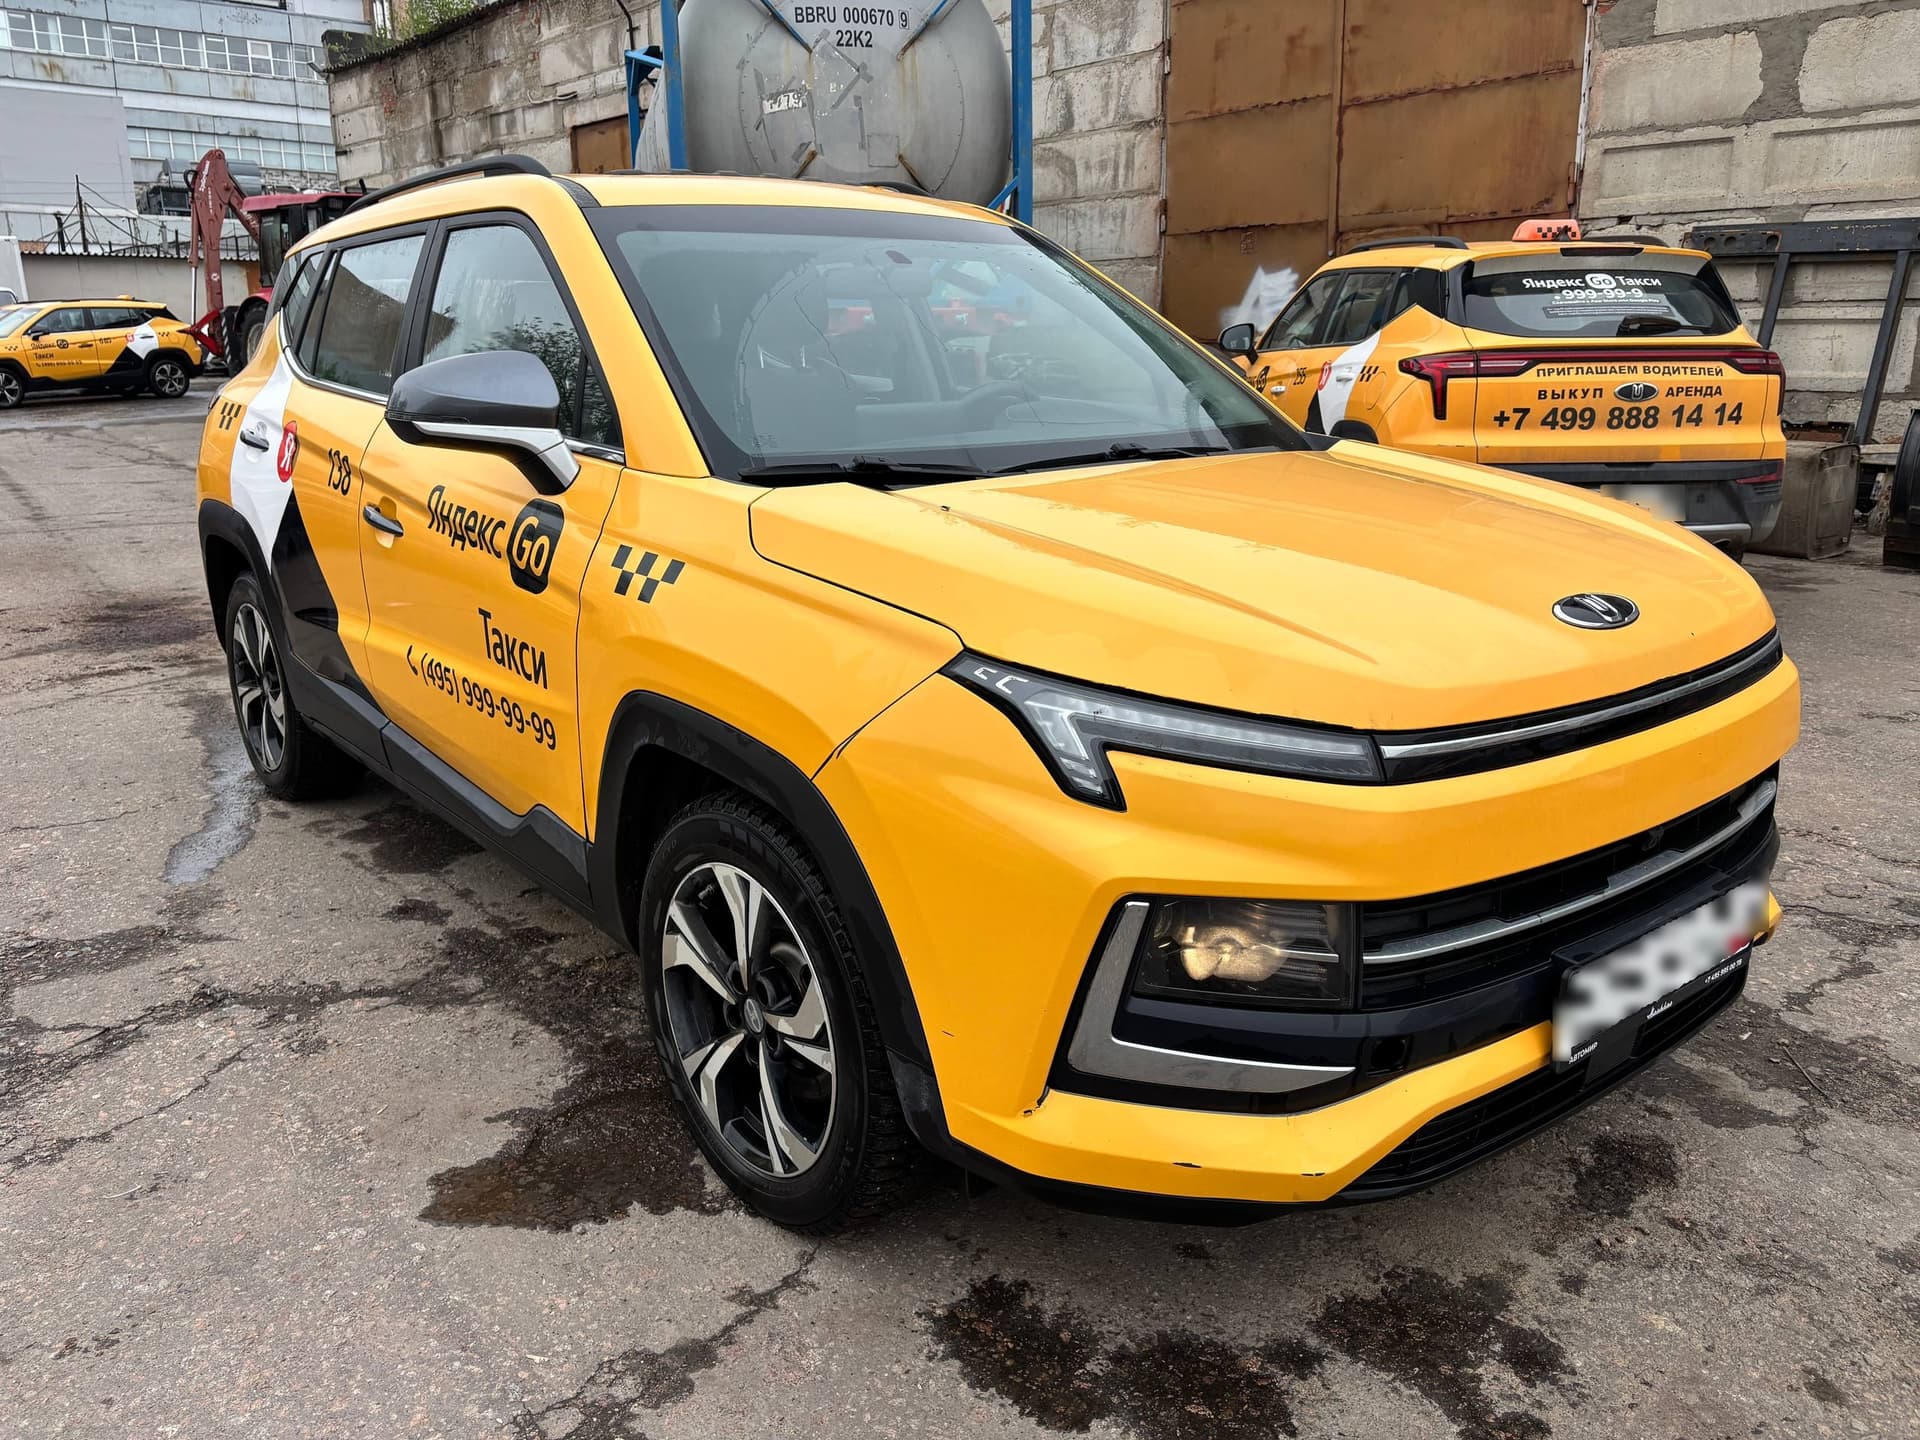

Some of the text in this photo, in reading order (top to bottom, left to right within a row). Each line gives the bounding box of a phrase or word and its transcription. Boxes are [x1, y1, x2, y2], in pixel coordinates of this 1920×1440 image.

[794, 6, 908, 28] BBRU 000670 9
[835, 29, 873, 48] 22K2
[1522, 277, 1585, 289] Яндекс
[1615, 275, 1662, 287] Такси
[1536, 364, 1724, 377] ПРИГЛАШАЕМ ВОДИТЕЛЕЙ
[1537, 385, 1723, 400] ВЫКУП АРЕНДА
[1493, 402, 1743, 430] +7 499 888 14 14
[280, 432, 296, 472] Я
[327, 447, 352, 496] 138
[427, 484, 550, 577] Яндекс Go
[478, 607, 548, 690] Такси
[420, 652, 556, 751] (495) 999-99-99
